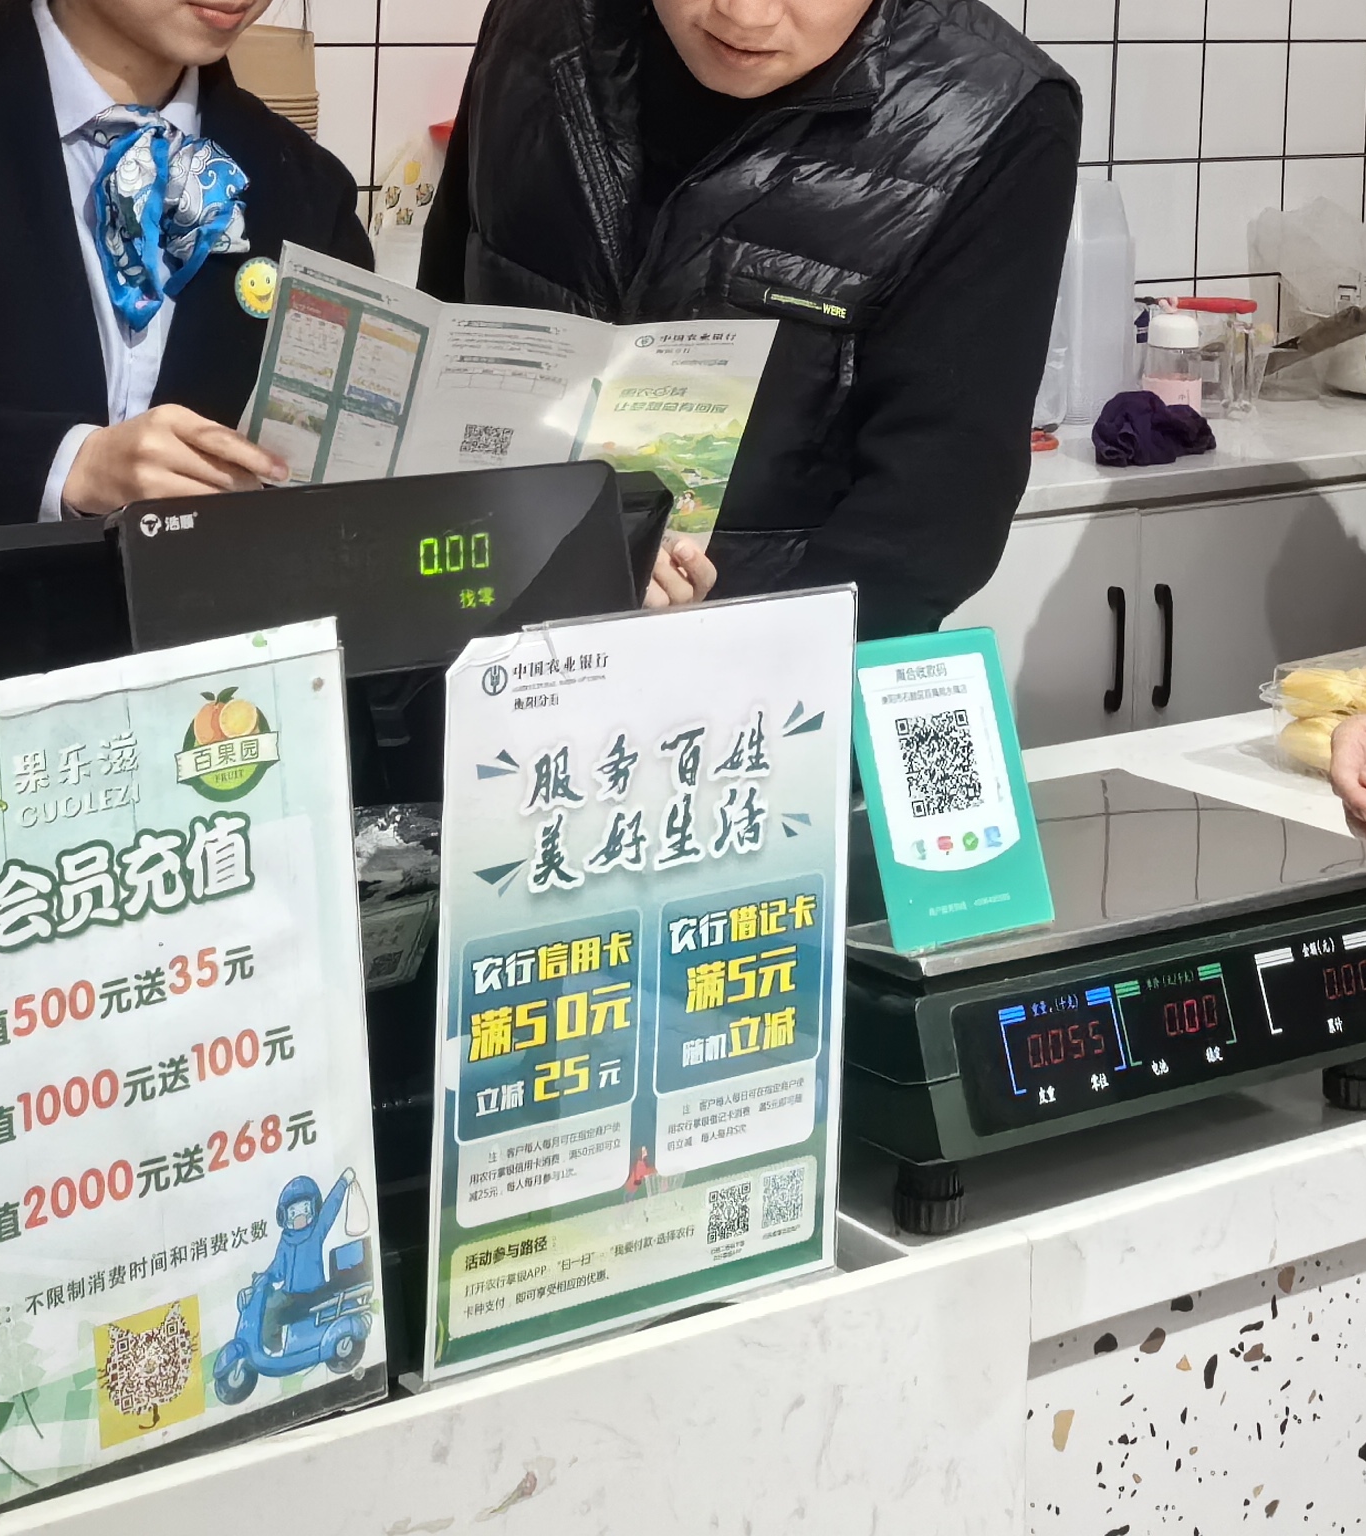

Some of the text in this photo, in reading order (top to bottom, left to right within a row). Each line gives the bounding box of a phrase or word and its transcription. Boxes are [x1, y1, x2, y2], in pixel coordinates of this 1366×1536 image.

[420, 532, 489, 575] 0.00
[459, 587, 495, 609] 找零
[513, 652, 609, 680] 中国农业银行
[13, 731, 139, 796] 果乐滋
[193, 737, 260, 772] 百果园
[212, 768, 246, 785] FRUIT
[527, 710, 771, 808] 服务百姓
[532, 787, 767, 886] 美好生活
[668, 894, 816, 955] 农行借记卡
[472, 930, 633, 995] 农行信用卡
[685, 945, 797, 1013] 满5元
[468, 982, 632, 1062] 满50元
[681, 1006, 797, 1068] 随机立减
[1027, 1020, 1105, 1069] 0.055
[1164, 994, 1218, 1037] 0.00
